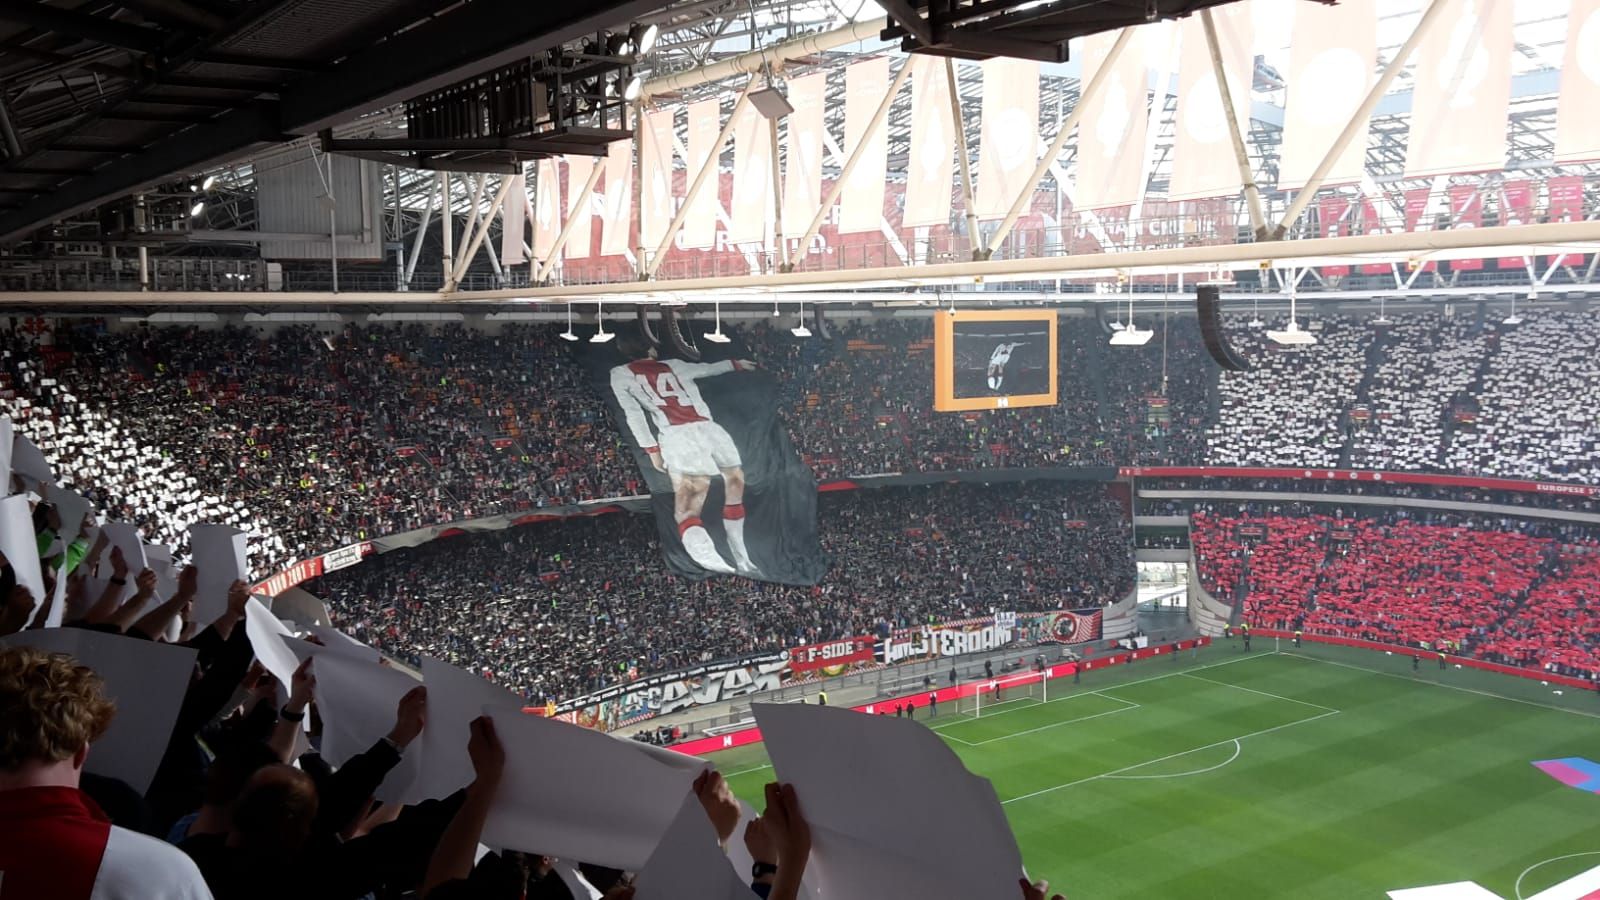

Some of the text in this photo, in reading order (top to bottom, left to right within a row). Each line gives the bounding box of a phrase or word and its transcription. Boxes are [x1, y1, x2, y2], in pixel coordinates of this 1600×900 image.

[634, 372, 694, 407] 14
[1536, 484, 1585, 494] EUROPESE
[807, 640, 854, 663] F-SIDE
